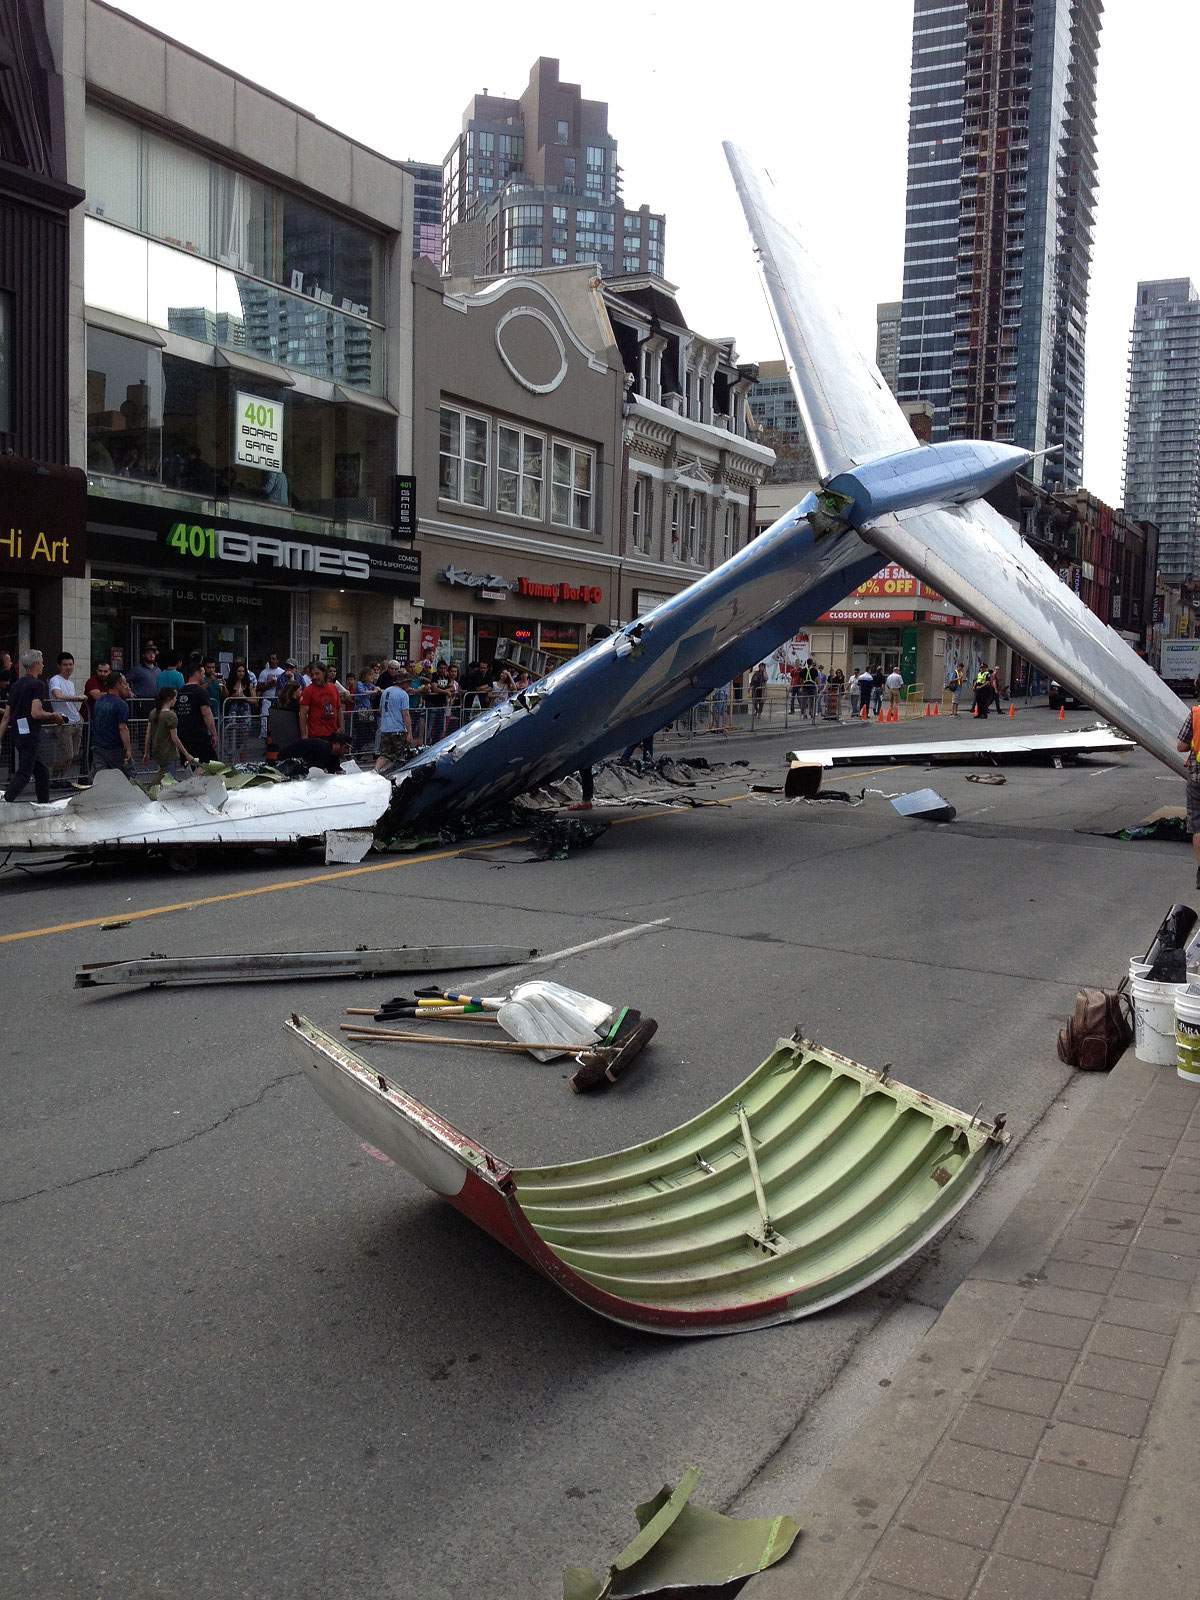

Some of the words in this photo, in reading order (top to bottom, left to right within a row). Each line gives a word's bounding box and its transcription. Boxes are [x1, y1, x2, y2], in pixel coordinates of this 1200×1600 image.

[245, 402, 274, 429] 401
[241, 425, 278, 441] BOARD
[245, 439, 274, 454] GAME
[238, 452, 280, 469] LOUNGE
[31, 532, 69, 564] Art
[518, 577, 560, 604] Yummy
[884, 580, 912, 593] OFF
[201, 592, 233, 603] COVER
[236, 596, 263, 606] PRICE
